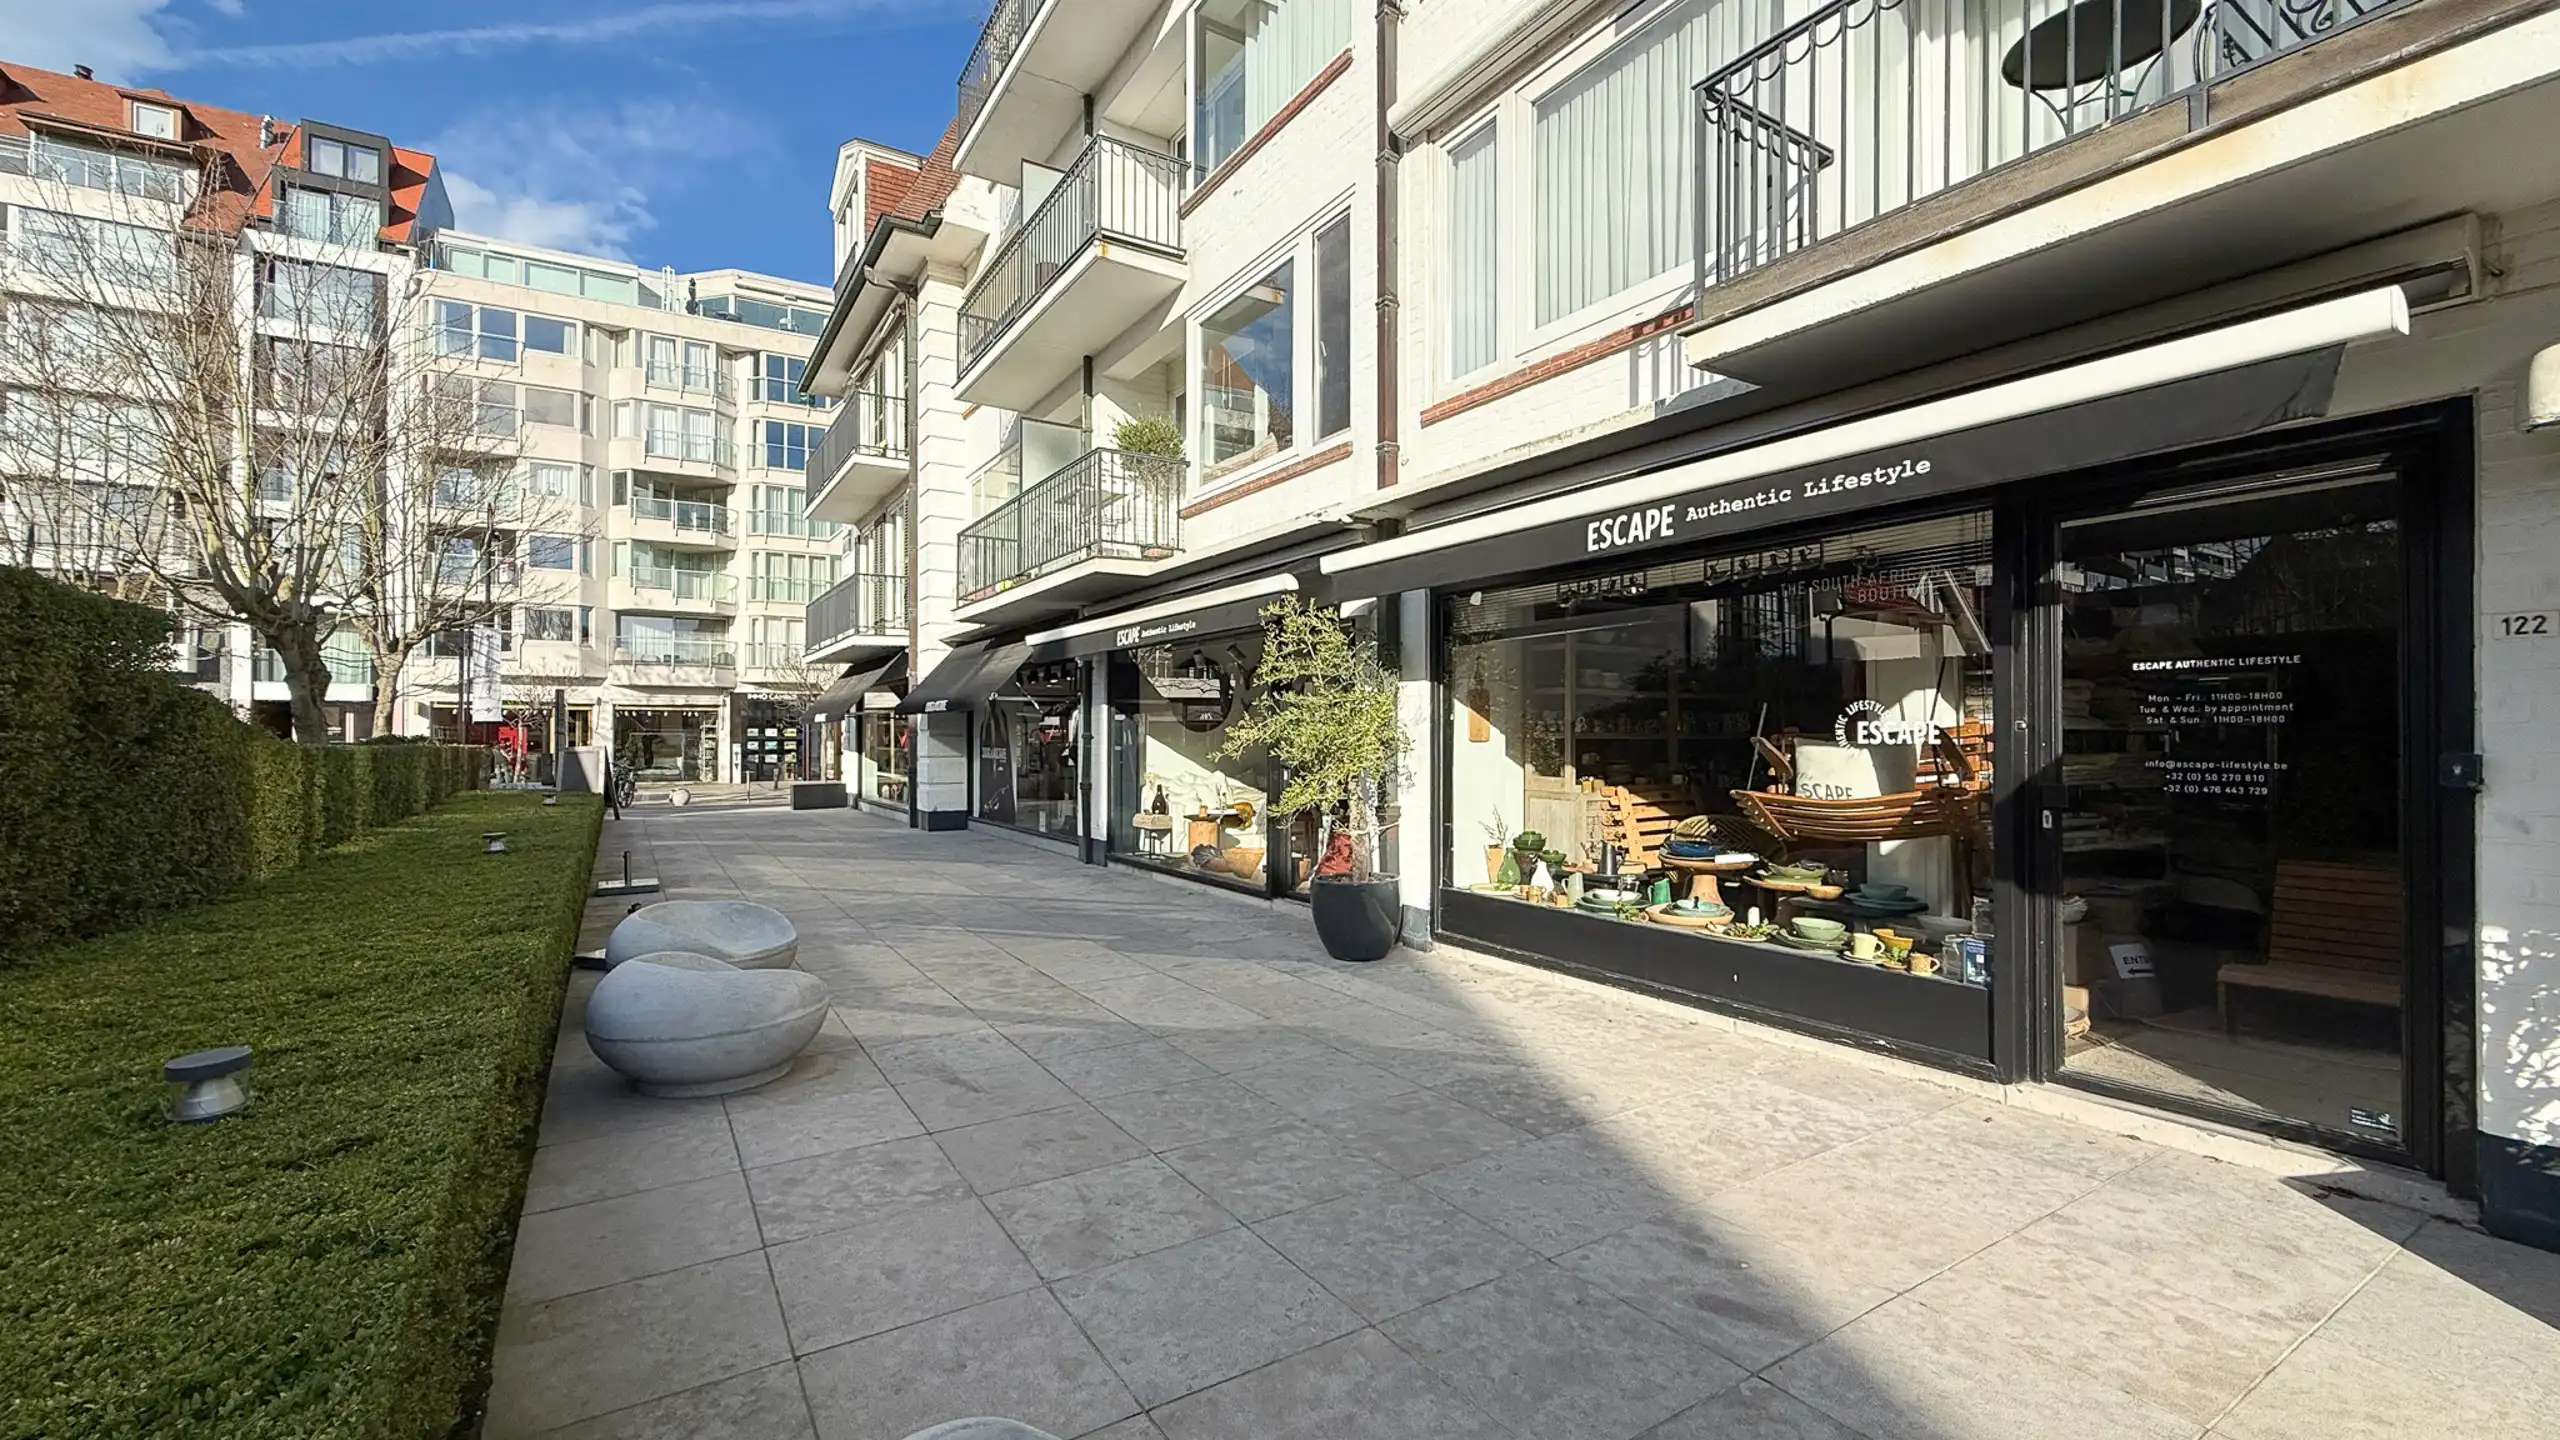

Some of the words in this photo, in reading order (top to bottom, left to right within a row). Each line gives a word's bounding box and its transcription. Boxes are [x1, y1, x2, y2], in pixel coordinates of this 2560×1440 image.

[1587, 504, 1676, 552] ESCAPE
[1685, 488, 1792, 522] Authentic
[1803, 458, 1931, 498] Lifestyle
[1780, 582, 1806, 596] THE
[1812, 574, 1861, 593] SOUTH
[2501, 615, 2548, 636] 122
[1116, 626, 1141, 647] ESCAPE
[2132, 660, 2173, 671] ESCAPE
[2175, 657, 2236, 669] AUTHENTIC
[2238, 655, 2302, 666] LIFESTYLE
[2211, 692, 2284, 701] 11H00-18H00
[2162, 705, 2170, 713] &
[2204, 705, 2217, 714] by
[2221, 702, 2294, 714] appointment
[2169, 716, 2177, 724] &
[2213, 715, 2286, 724] 11H00-18H00
[1857, 720, 1941, 746] ESCAPE
[2145, 760, 2289, 771] info@escape-lifestyle.be
[2187, 772, 2202, 782] (0)
[2205, 773, 2218, 782] 50
[2221, 773, 2241, 782] 270
[2245, 774, 2265, 783] 810
[2184, 784, 2199, 794] (0)
[2202, 785, 2221, 794] 476
[2225, 786, 2244, 795] 443
[2248, 786, 2268, 795] 729
